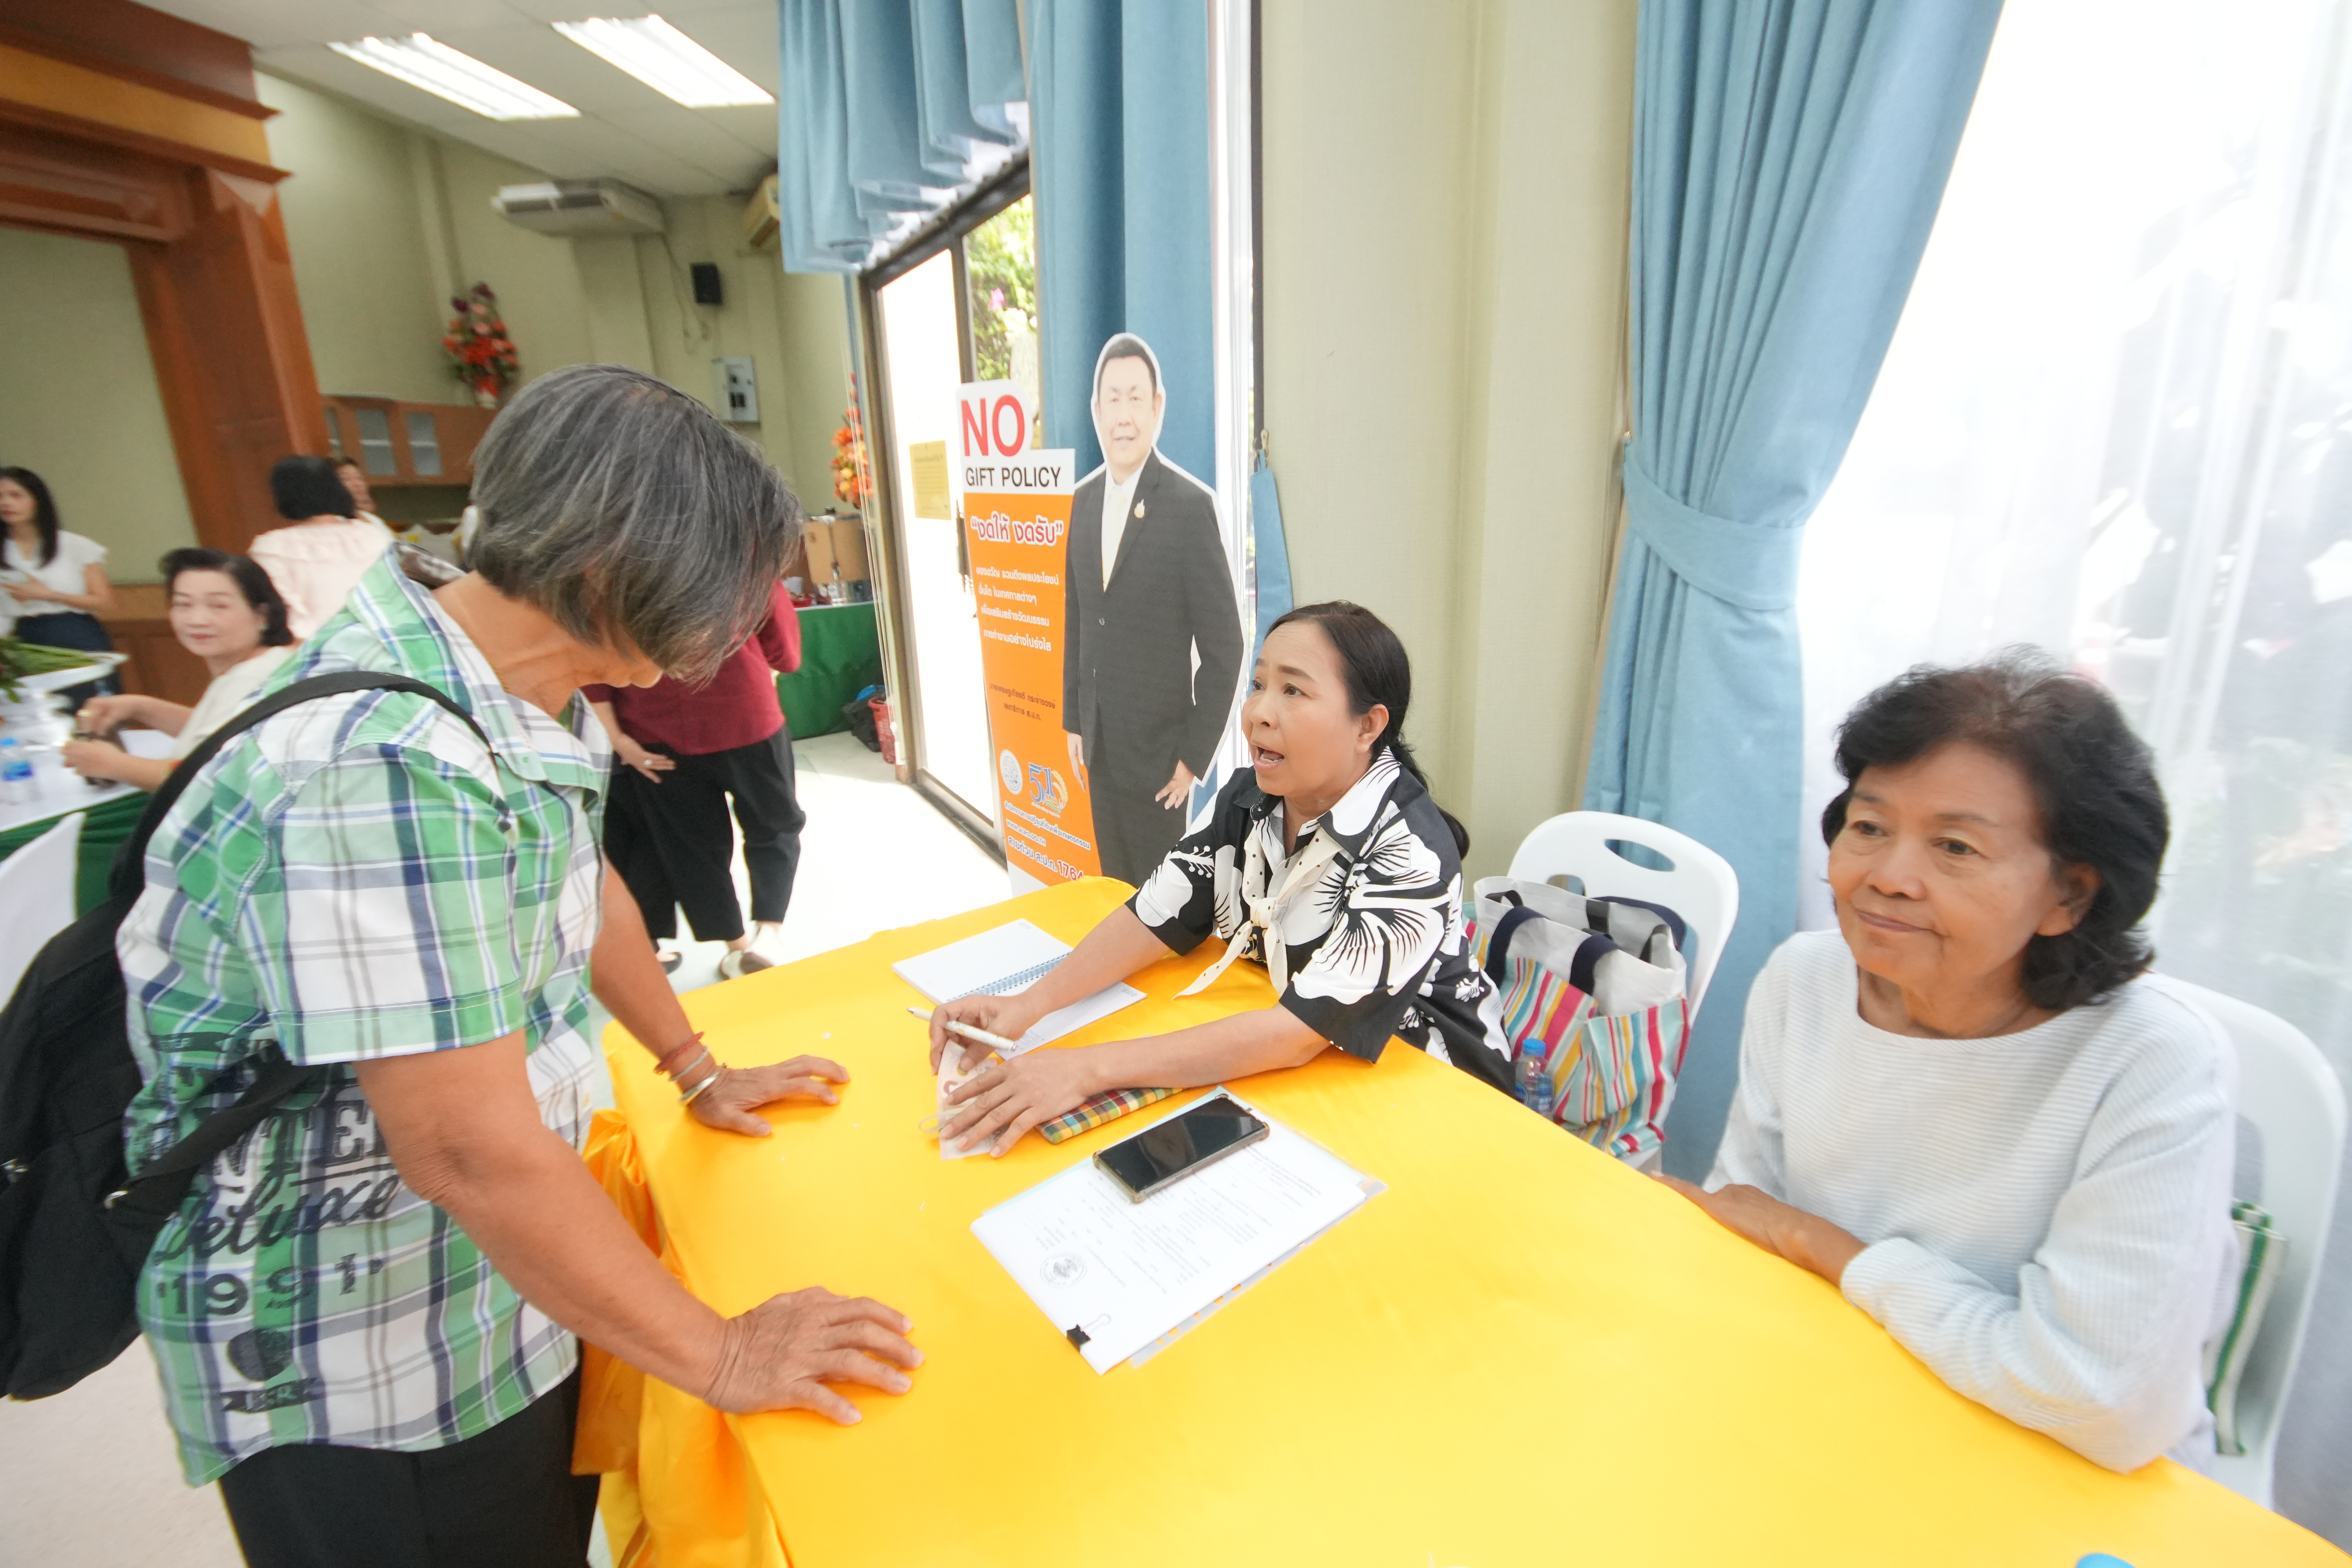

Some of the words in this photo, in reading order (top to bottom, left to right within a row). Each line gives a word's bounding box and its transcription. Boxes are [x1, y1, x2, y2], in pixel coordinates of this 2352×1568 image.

[961, 394, 1025, 457] NO
[966, 467, 994, 487] GIFT
[1002, 466, 1061, 487] POLICY
[1002, 569, 1059, 585] รวมถึงผลประโยชน์
[980, 602, 1050, 627] เพื่อเสริมสร้างวัฒนธรรม
[983, 629, 1051, 652] การทำงานอย่างโปร่งใส
[1028, 762, 1056, 803] 51
[1008, 837, 1034, 858] สายด่วน
[1036, 853, 1057, 871] ส.ป.ก.
